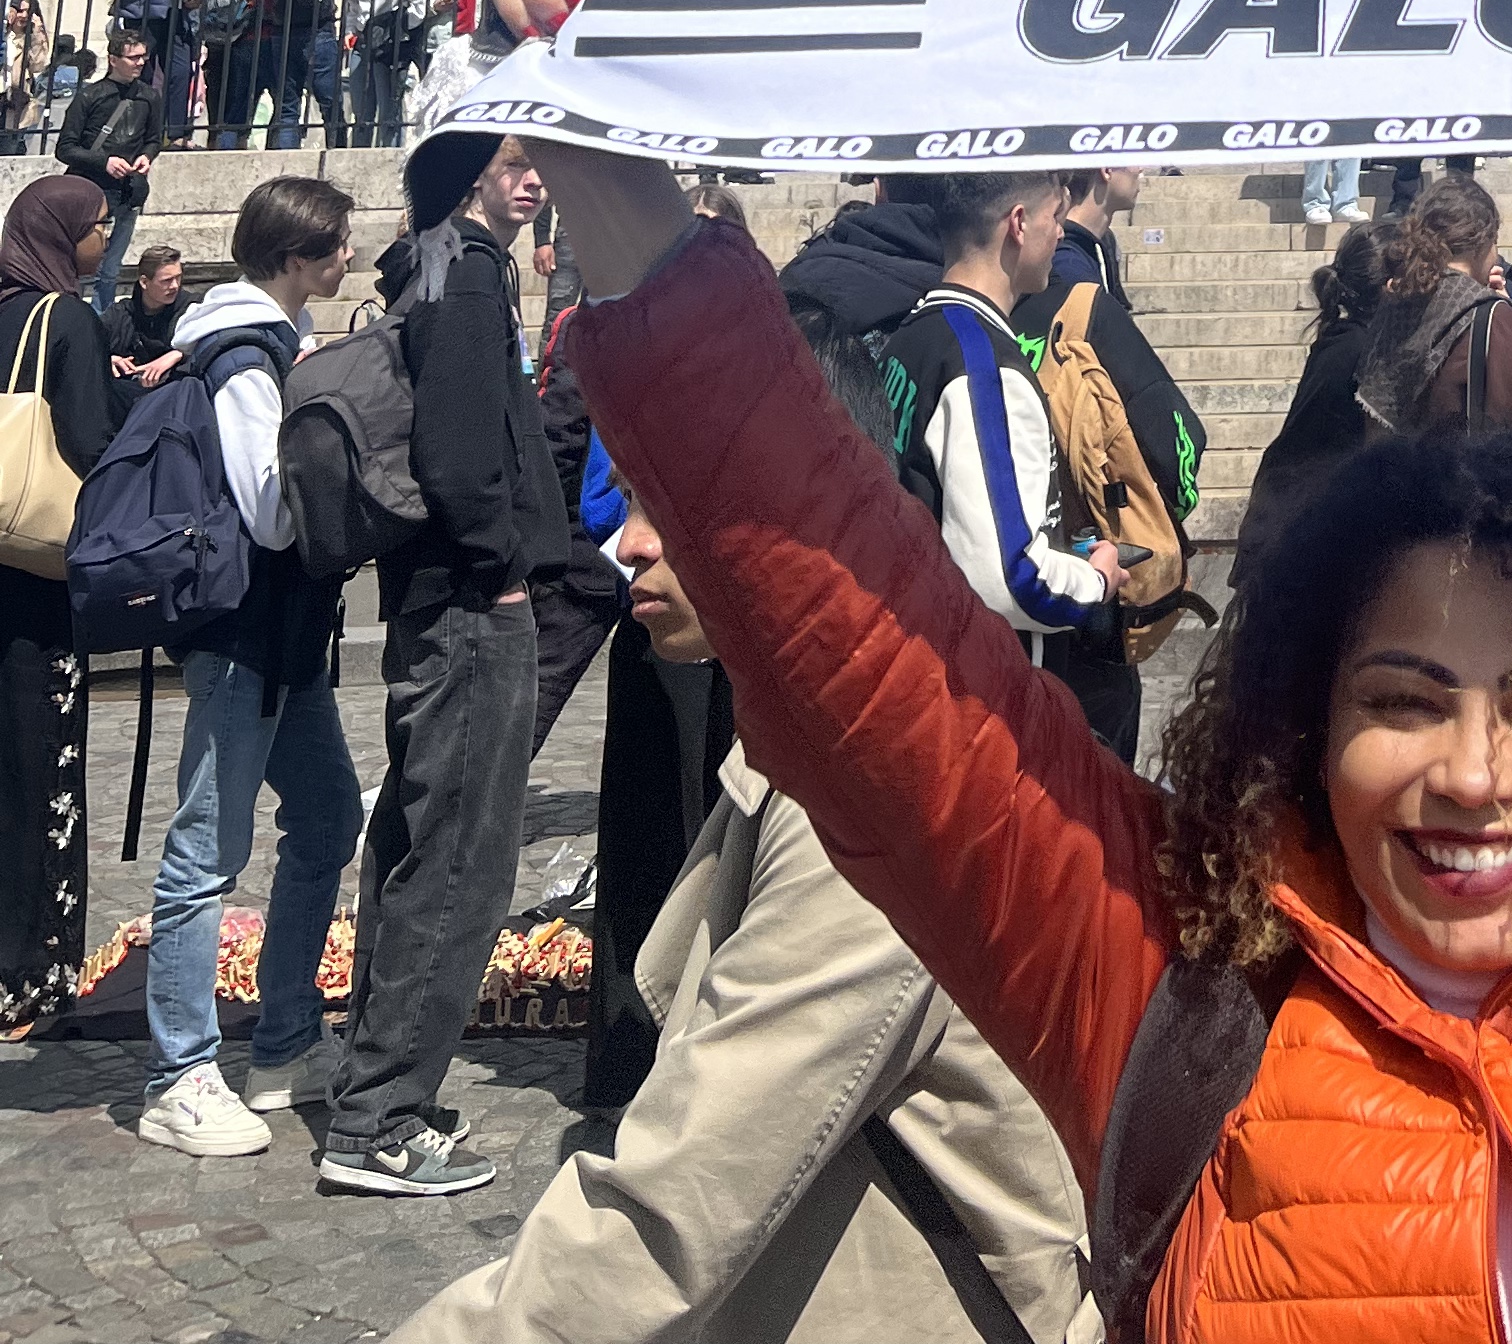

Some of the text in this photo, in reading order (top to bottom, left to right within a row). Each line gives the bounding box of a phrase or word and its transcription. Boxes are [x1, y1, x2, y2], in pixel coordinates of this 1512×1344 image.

[454, 102, 566, 125] GALO
[606, 127, 719, 155] GALO
[761, 136, 873, 159] GALO
[916, 128, 1025, 159] GALO
[1069, 123, 1178, 153] GALO
[1222, 120, 1331, 149] GALO
[1374, 116, 1482, 144] GALO
